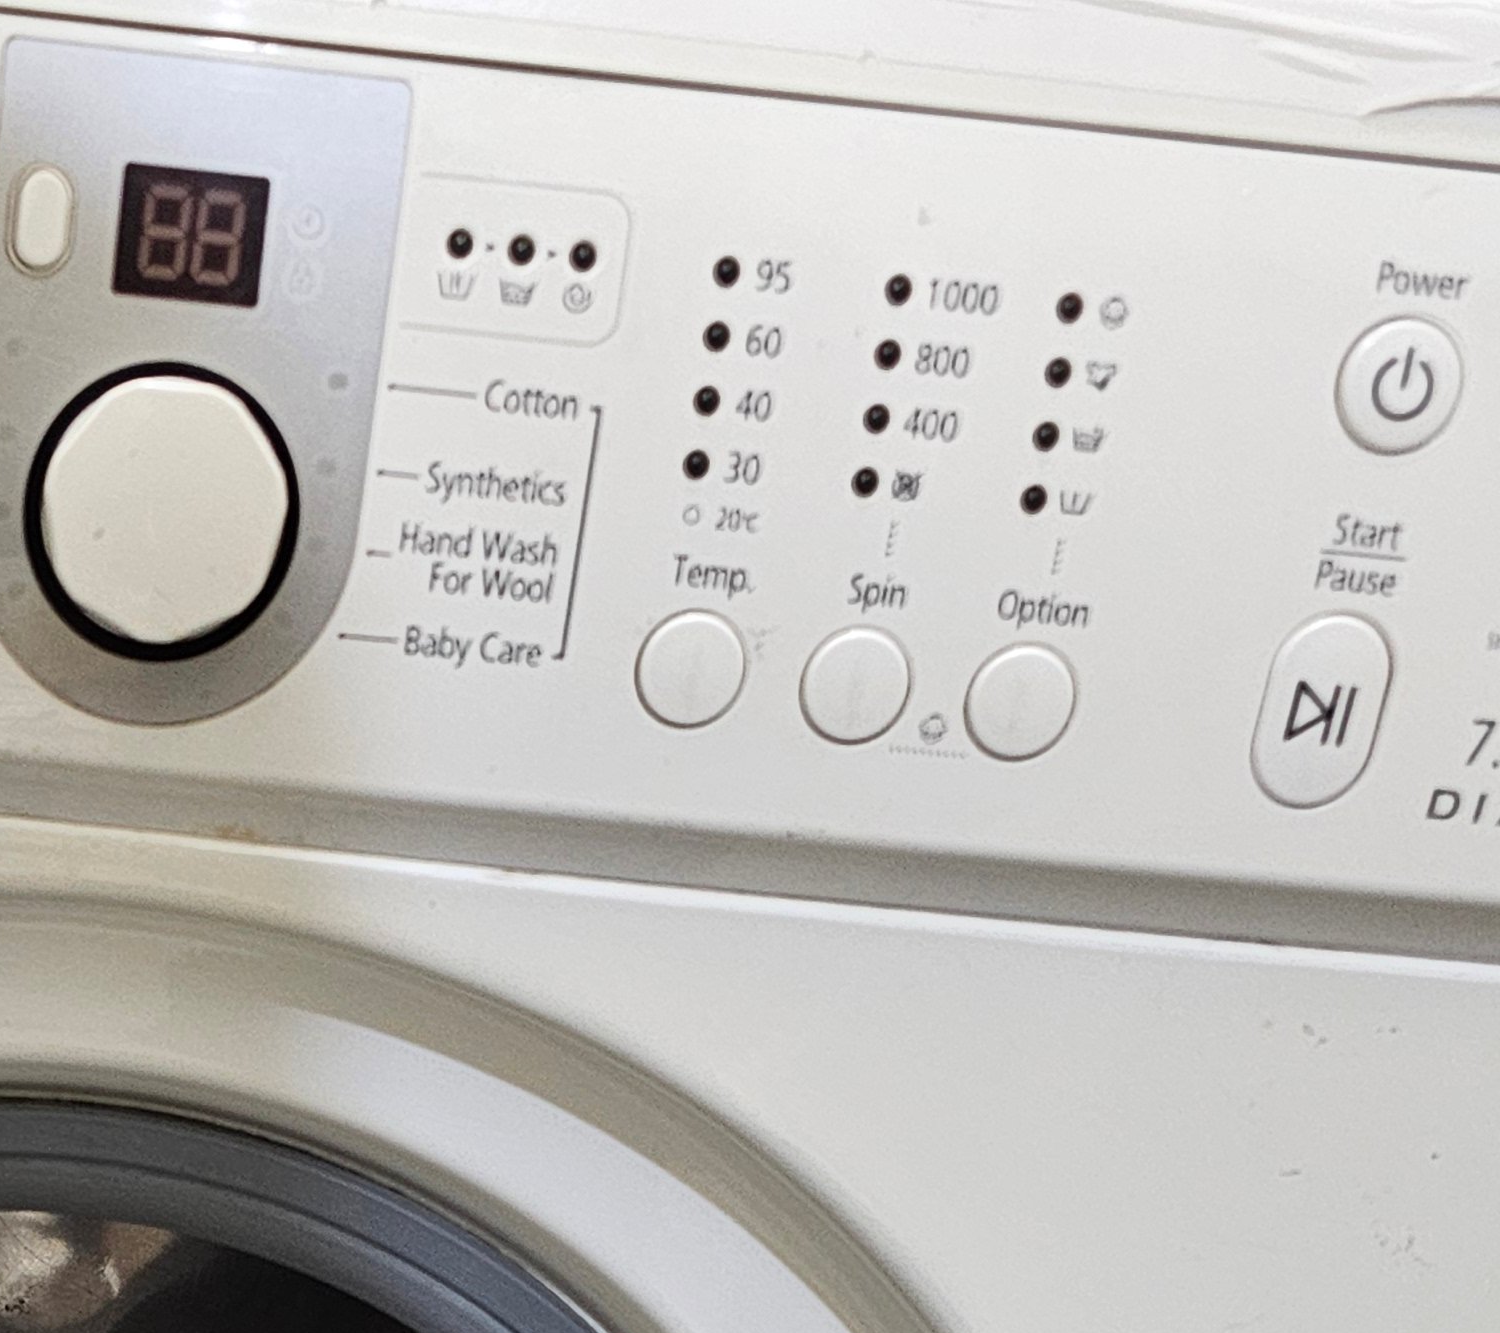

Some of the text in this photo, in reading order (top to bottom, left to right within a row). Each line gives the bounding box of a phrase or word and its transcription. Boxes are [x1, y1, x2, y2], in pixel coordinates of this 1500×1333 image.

[756, 258, 793, 295] 95
[1376, 259, 1470, 300] Power
[929, 278, 999, 316] 1000
[745, 323, 783, 359] 60
[914, 343, 970, 379] 800
[484, 378, 579, 421] Cotton
[735, 389, 772, 423] 40
[903, 407, 959, 443] 400
[426, 460, 566, 507] Synthetics
[724, 450, 761, 486] 30
[398, 522, 558, 567] Hand Wash
[1332, 513, 1406, 553] Start
[428, 560, 555, 603] For Wool
[674, 553, 758, 600] Temp.
[847, 573, 906, 614] Spin
[1314, 559, 1397, 598] Pause
[997, 589, 1090, 630] Option
[403, 624, 543, 669] Baby Care
[1426, 788, 1500, 827] DI
